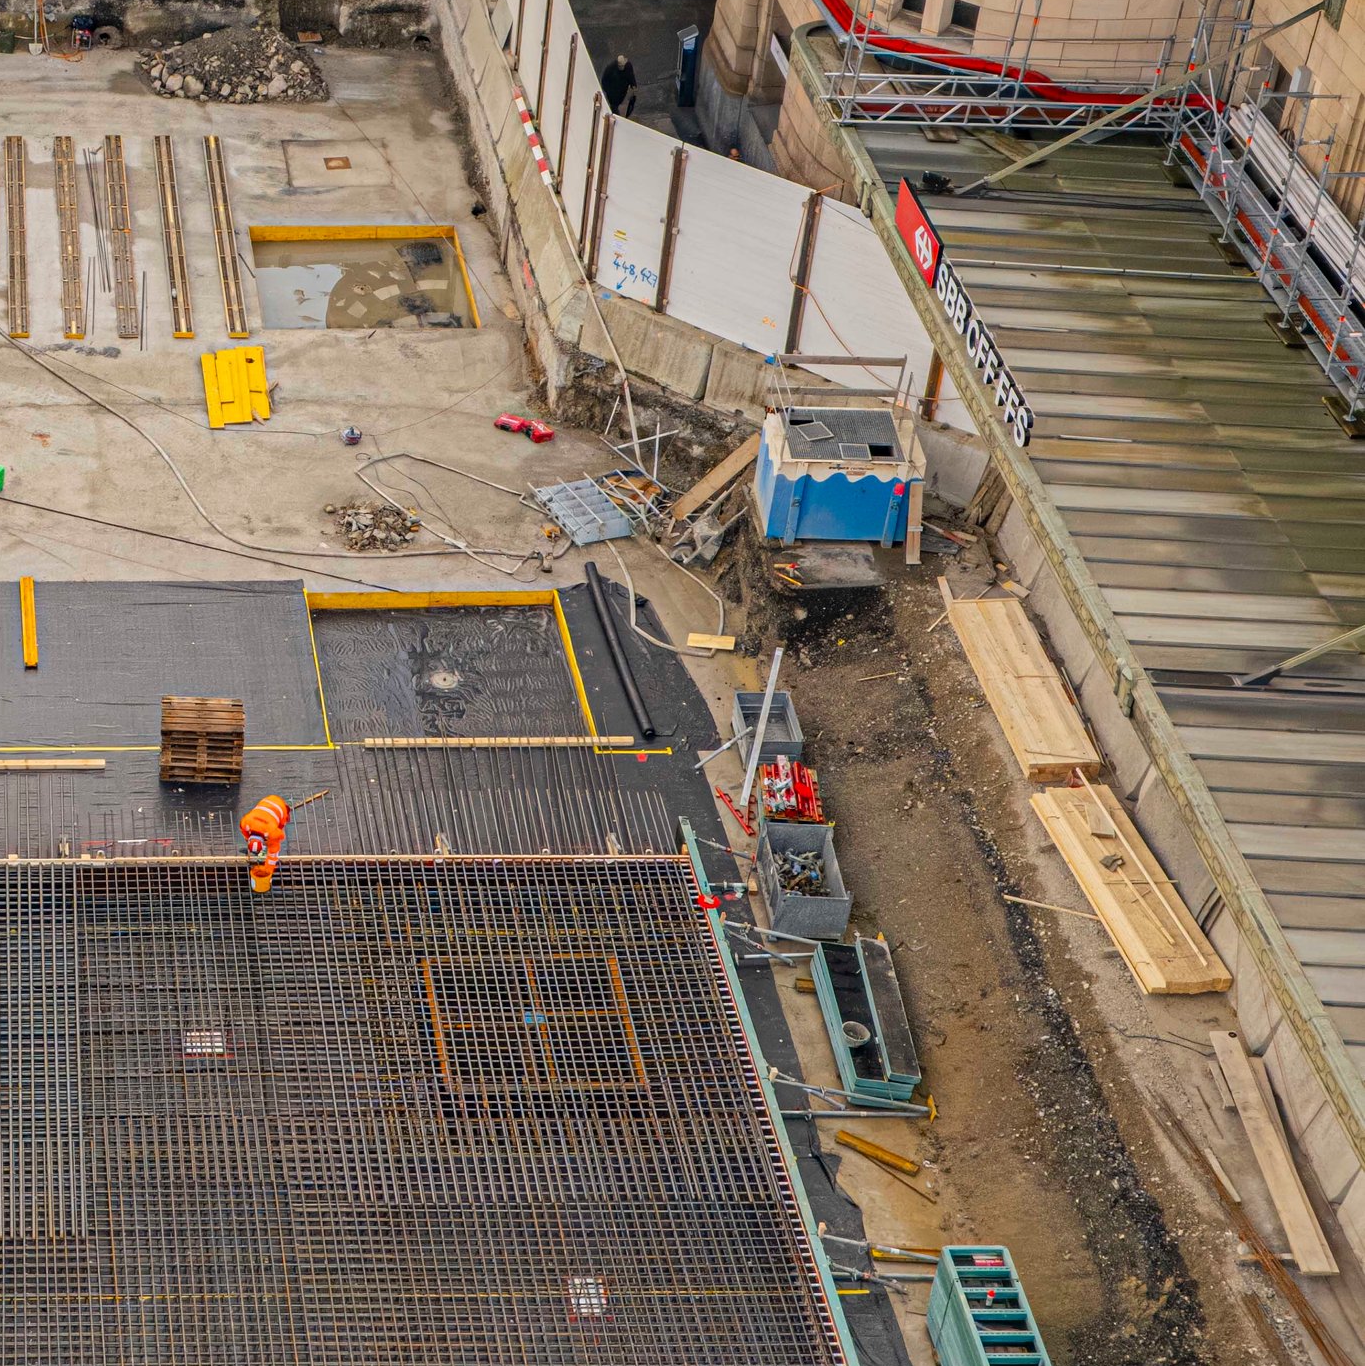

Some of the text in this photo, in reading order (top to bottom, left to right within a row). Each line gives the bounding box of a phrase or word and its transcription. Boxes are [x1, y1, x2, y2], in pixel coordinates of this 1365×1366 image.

[936, 262, 1033, 448] SBB CFF FFS
